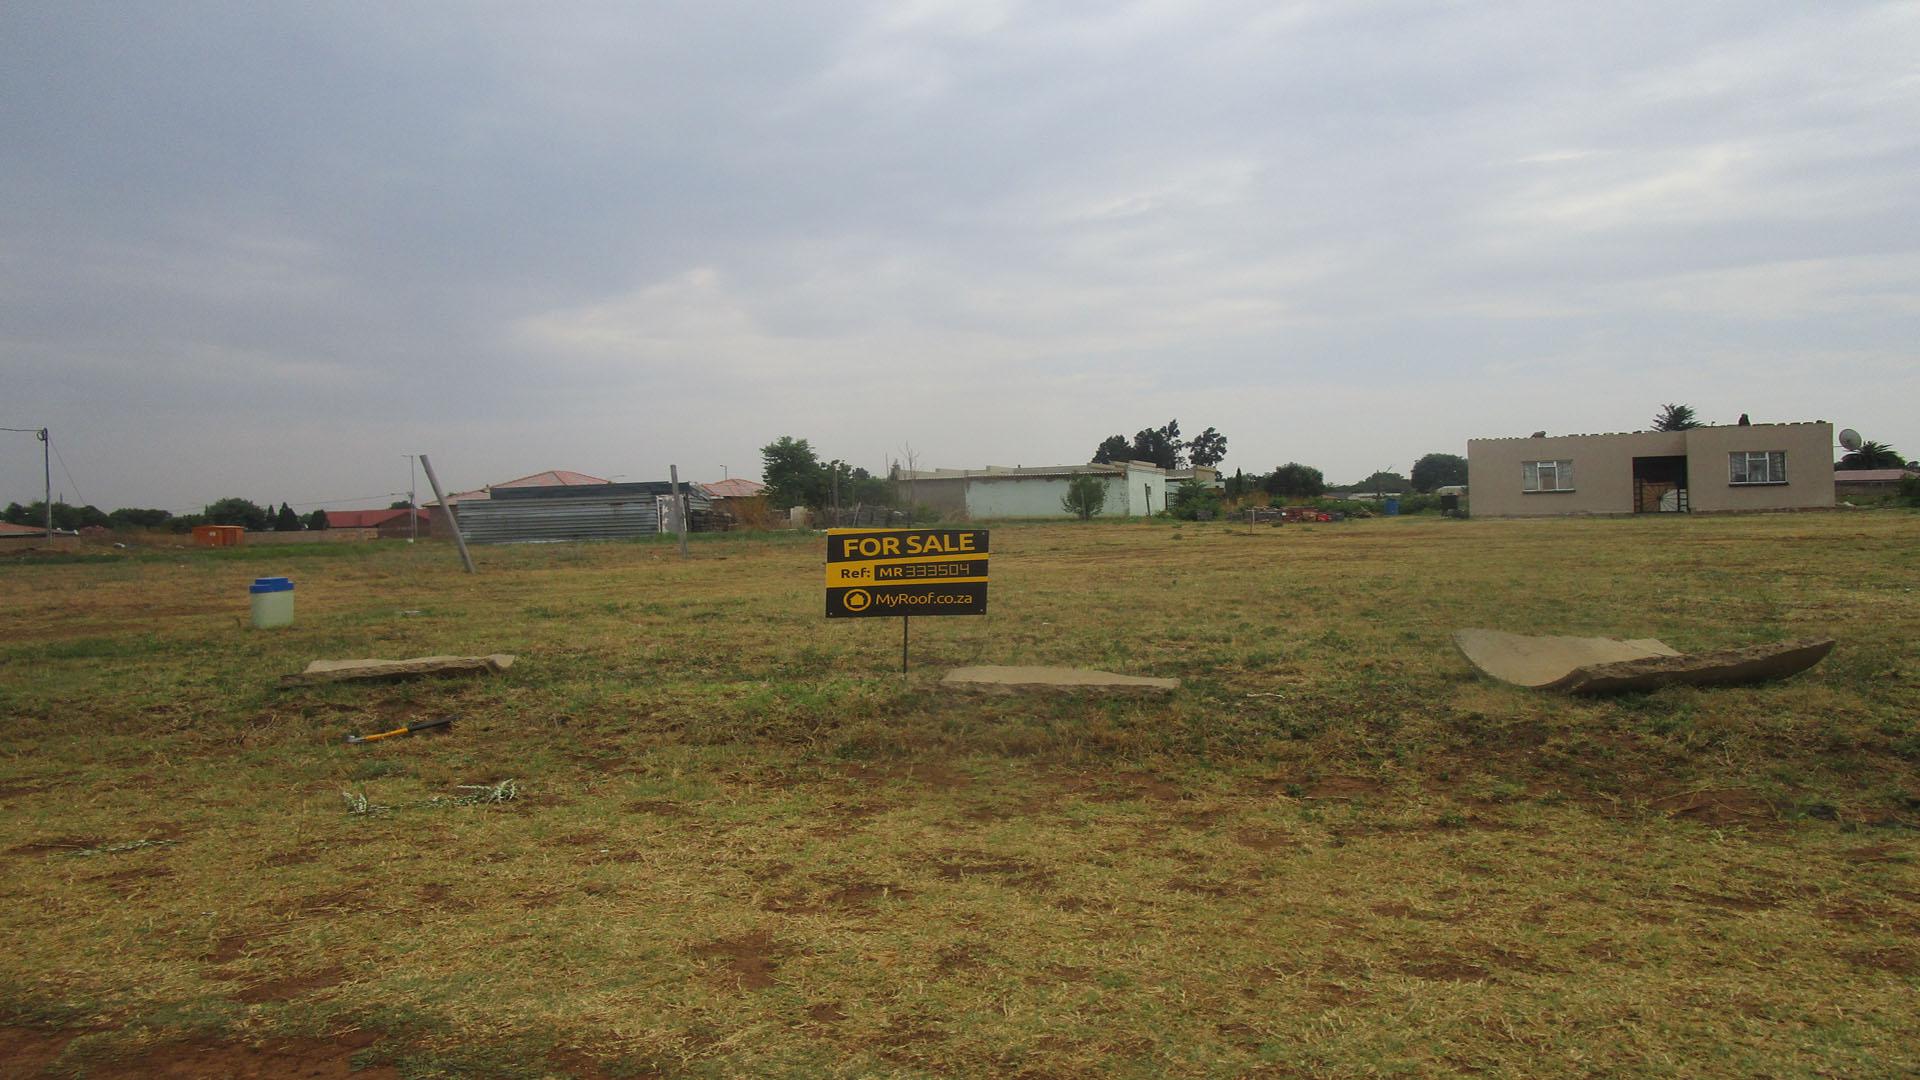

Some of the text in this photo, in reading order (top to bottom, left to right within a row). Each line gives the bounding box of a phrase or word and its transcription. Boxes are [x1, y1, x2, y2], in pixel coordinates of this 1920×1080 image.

[843, 533, 976, 558] FOR SALE
[840, 563, 970, 579] Ref: MR 333504
[875, 592, 973, 608] MyRoof.co.za
